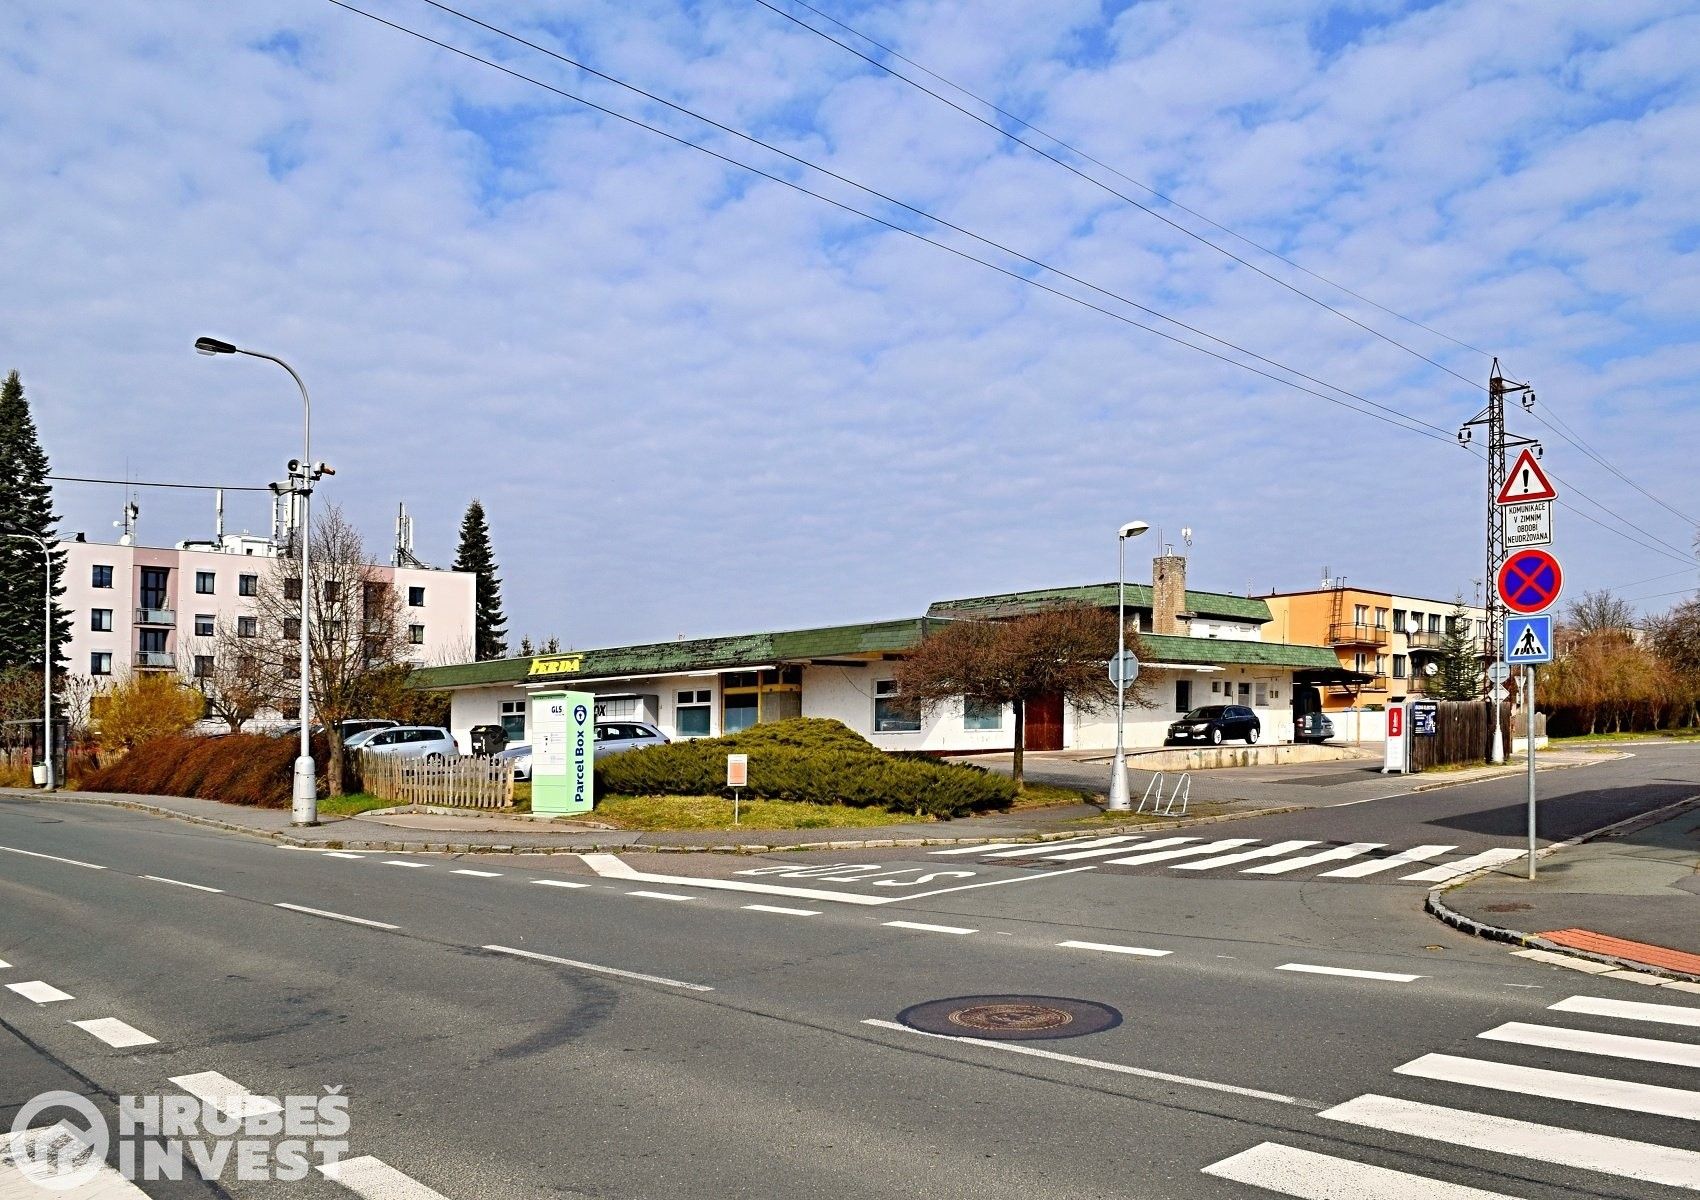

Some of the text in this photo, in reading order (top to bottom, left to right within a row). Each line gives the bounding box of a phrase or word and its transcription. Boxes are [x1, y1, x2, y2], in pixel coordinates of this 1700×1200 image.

[1508, 503, 1546, 514] KOMUNIKACE
[1520, 512, 1541, 523] ZIMNÍM
[1517, 521, 1538, 533] OBDOBÍ
[1507, 530, 1548, 544] NEUDRŽOVÁNA
[528, 655, 583, 675] FERDA
[551, 705, 562, 713] GLS
[575, 730, 584, 802] Parcel Box
